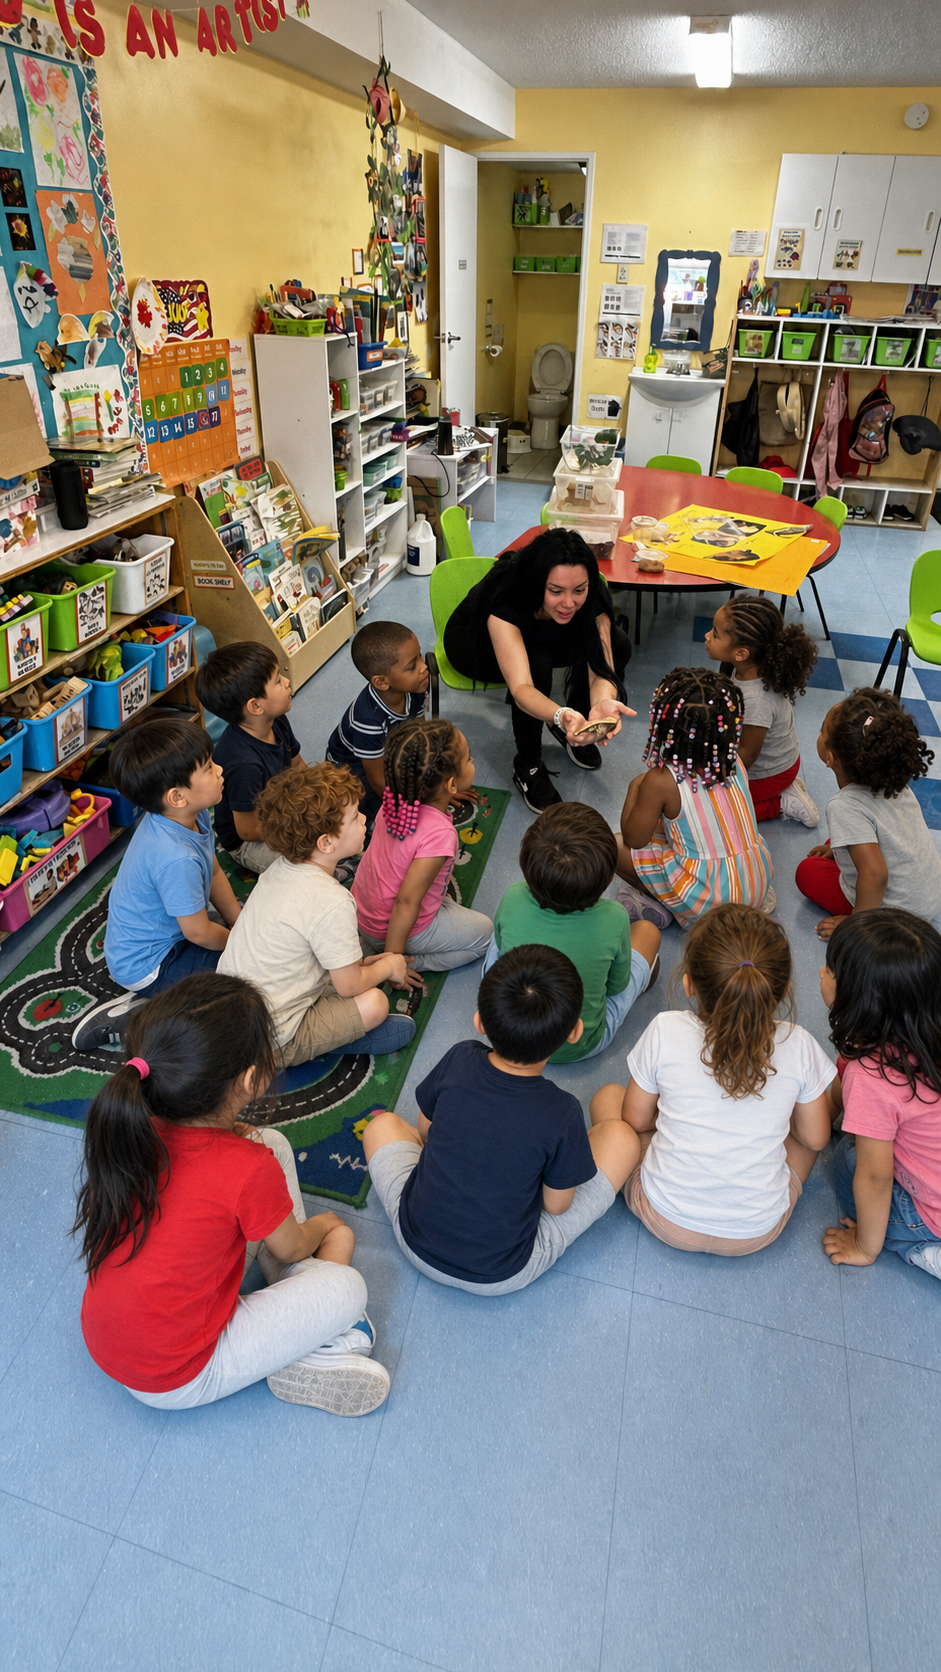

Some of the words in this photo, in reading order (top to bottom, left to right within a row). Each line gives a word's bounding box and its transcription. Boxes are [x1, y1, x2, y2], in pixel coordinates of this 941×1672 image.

[54, 0, 106, 57] IS
[126, 4, 179, 59] AN
[184, 372, 189, 382] 1
[195, 369, 201, 380] 2
[207, 367, 213, 378] 3
[219, 362, 225, 371] 4
[145, 405, 151, 416] 5
[160, 401, 166, 412] 6
[172, 397, 178, 409] 7
[197, 392, 203, 403] 9
[146, 426, 156, 438] 12
[160, 425, 169, 437] 13
[187, 417, 195, 430] 15
[198, 577, 213, 585] BOOK
